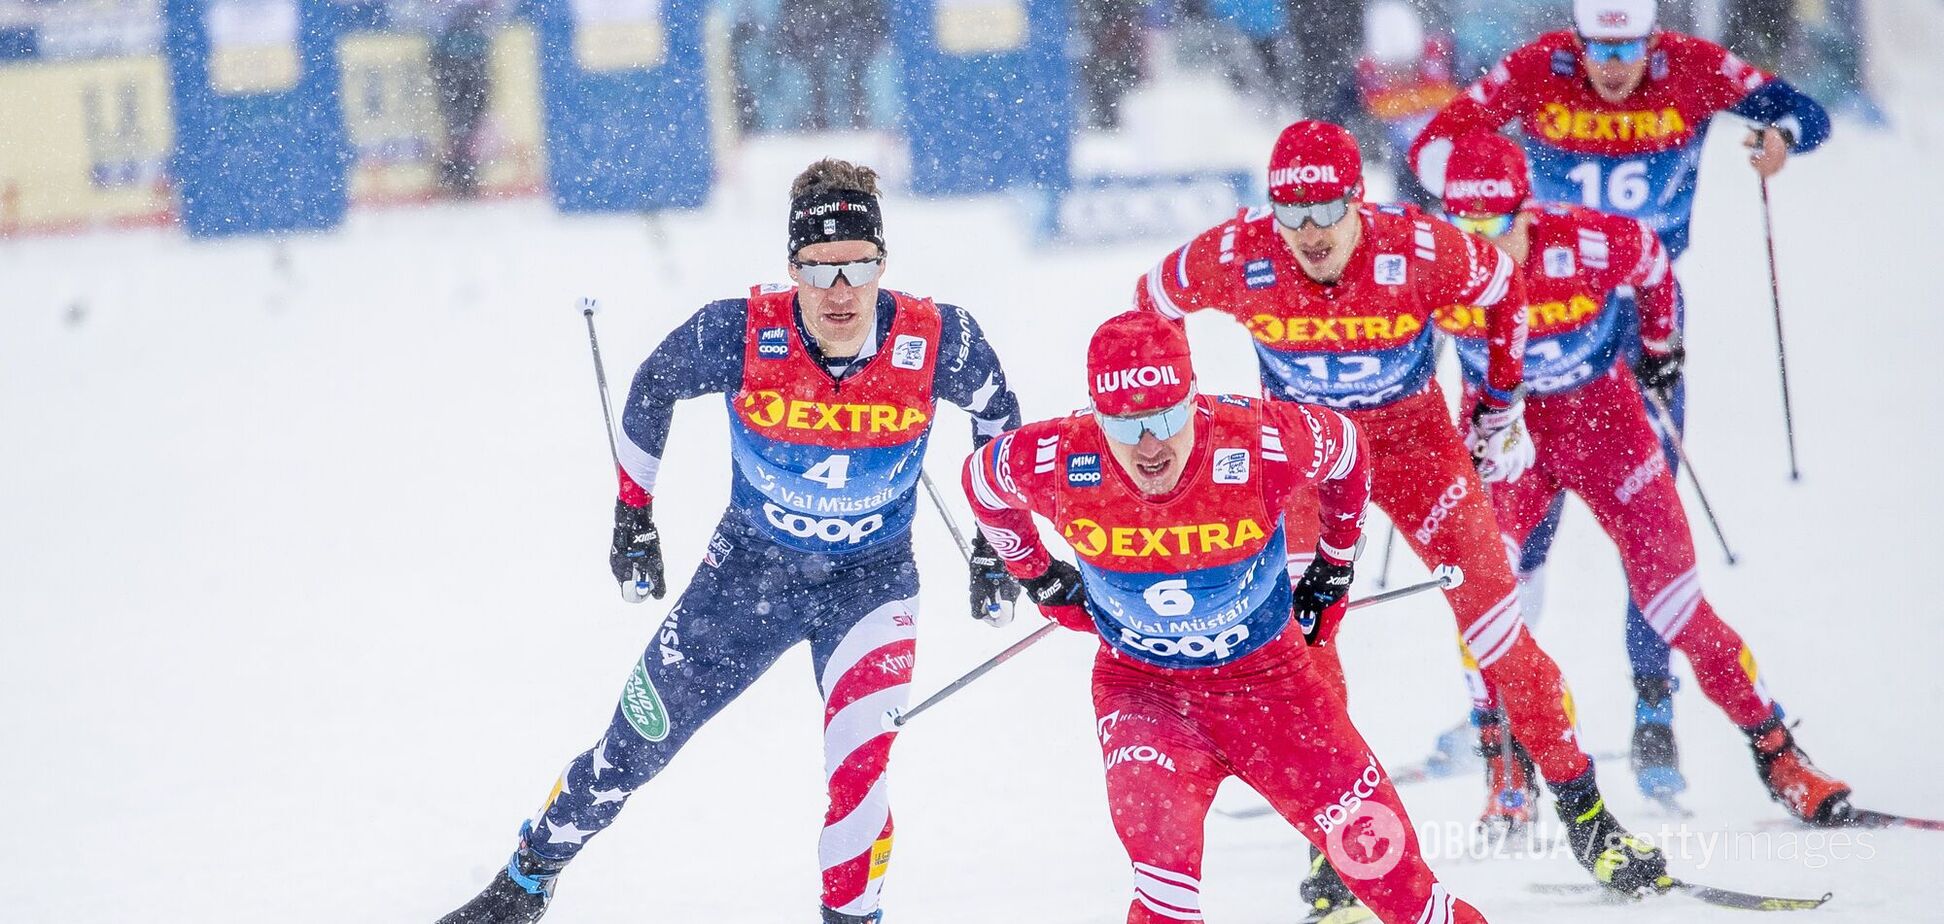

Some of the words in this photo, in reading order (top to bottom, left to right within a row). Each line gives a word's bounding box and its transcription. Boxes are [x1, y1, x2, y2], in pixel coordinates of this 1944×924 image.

[1573, 109, 1686, 141] EXTRA
[1270, 166, 1339, 188] LUKOIL
[1569, 162, 1651, 210] 16
[1286, 313, 1422, 341] EXTRA
[759, 344, 789, 356] coop
[1096, 365, 1181, 394] LUKOIL
[786, 400, 927, 433] EXTRA
[802, 454, 851, 489] 4
[1068, 471, 1102, 484] coop
[780, 487, 813, 510] Val
[817, 487, 896, 513] Müstair
[1415, 483, 1467, 545] BOSCO
[762, 502, 884, 544] coop
[1110, 519, 1265, 557] EXTRA
[1128, 613, 1164, 634] Val
[1168, 596, 1250, 634] Müstair
[1142, 579, 1195, 617] 6
[1119, 623, 1250, 660] coop
[1313, 764, 1381, 835] BOSCO
